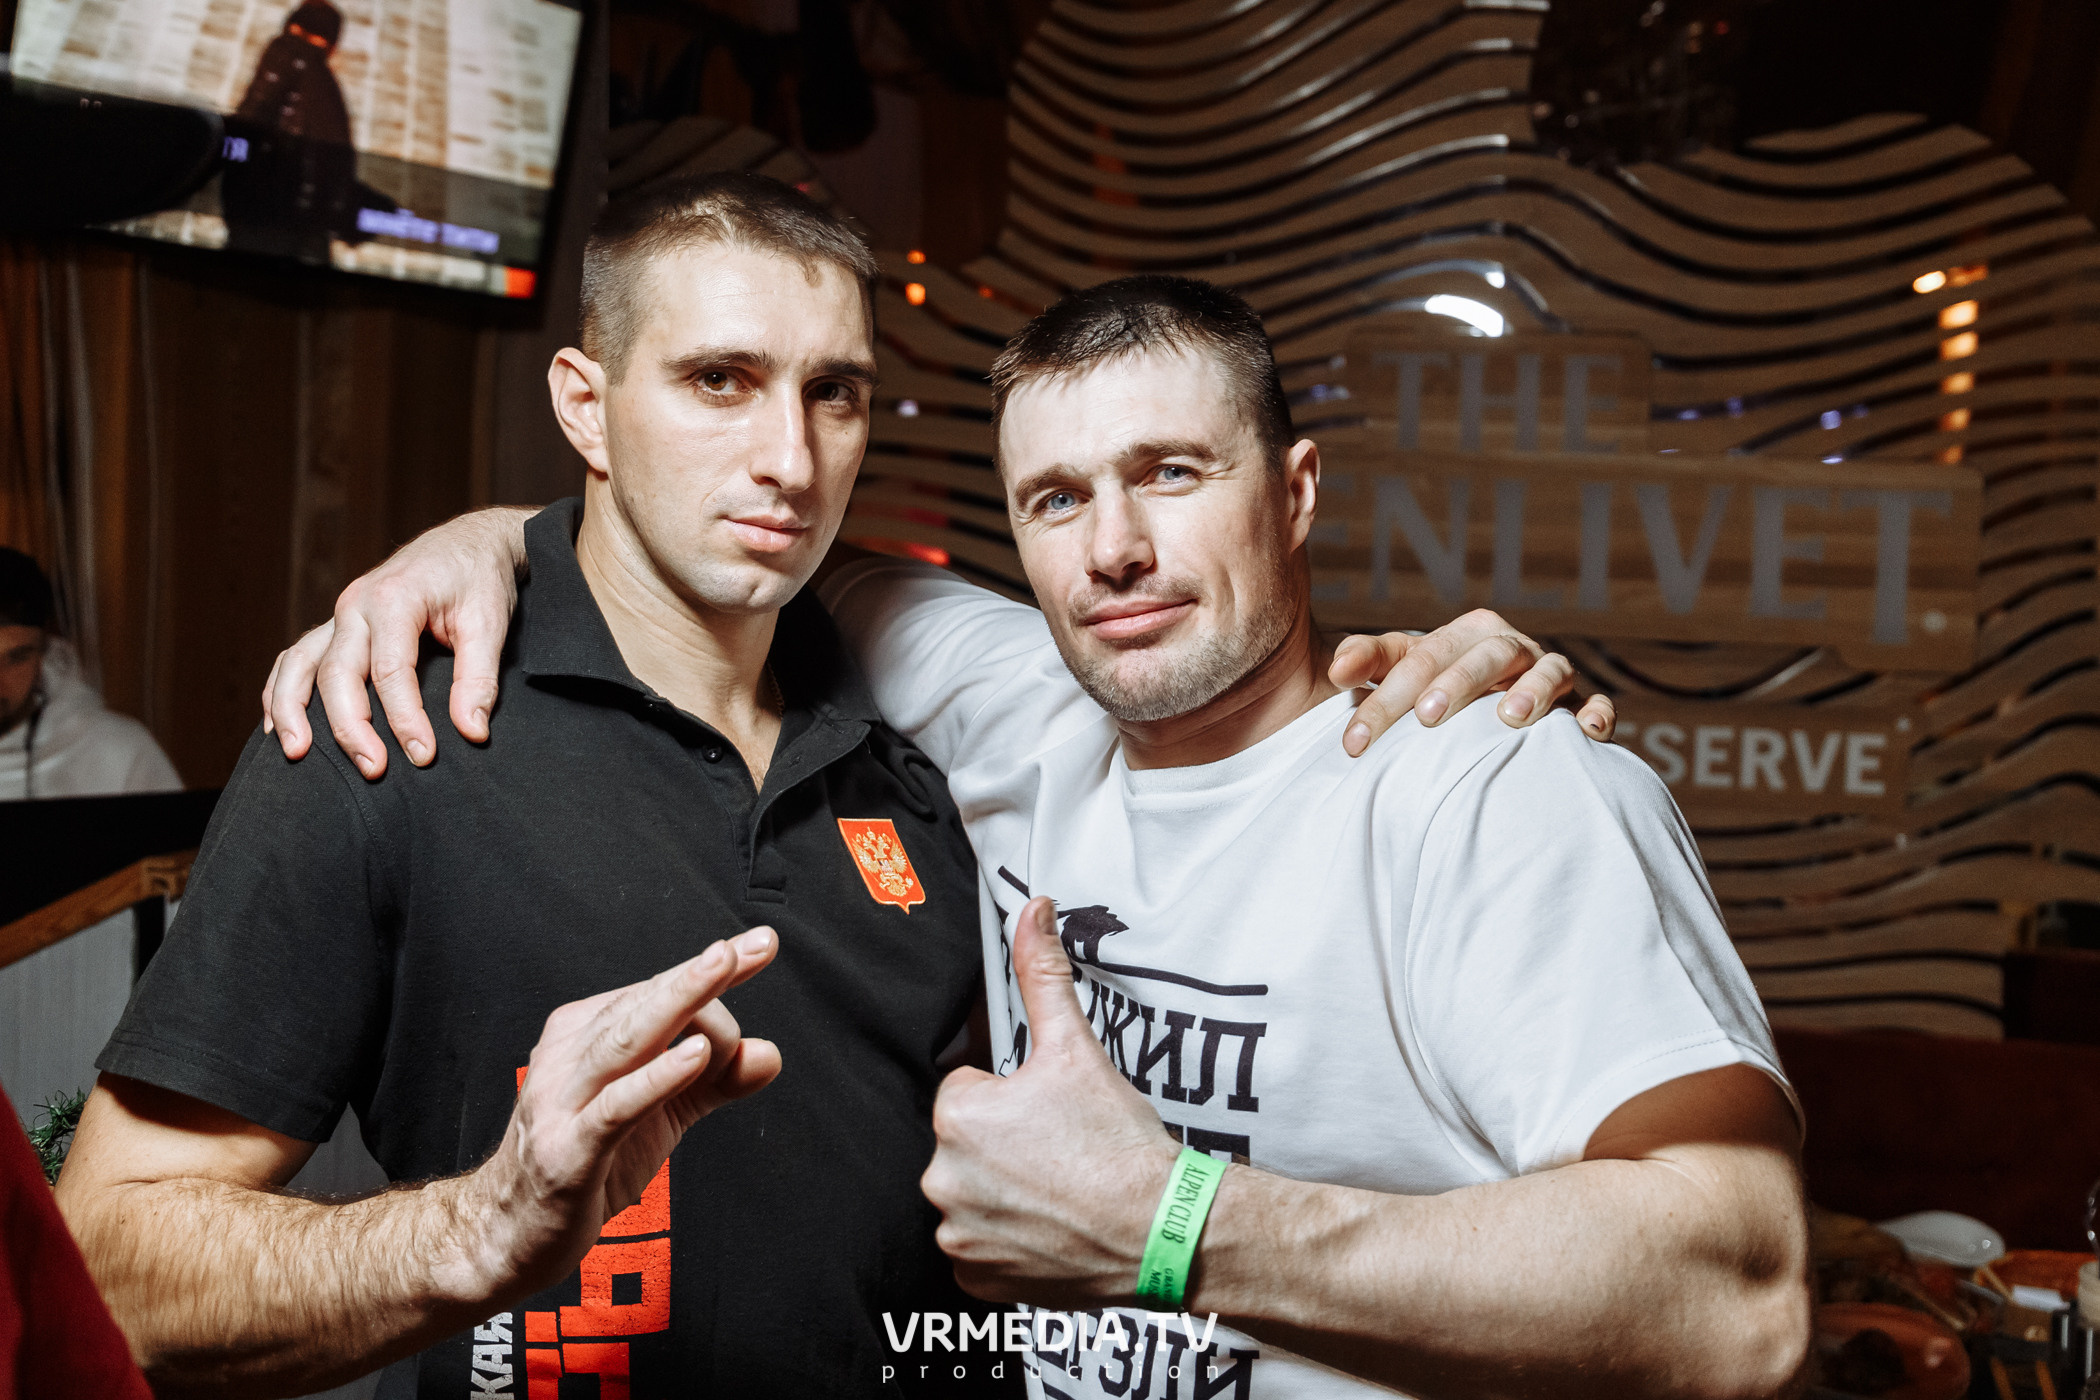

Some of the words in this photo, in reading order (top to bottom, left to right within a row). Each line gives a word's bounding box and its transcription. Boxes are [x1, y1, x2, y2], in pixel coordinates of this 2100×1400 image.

[1371, 352, 1623, 453] THE
[1173, 1163, 1210, 1207] ALPEN
[1162, 1204, 1192, 1244] CLUB
